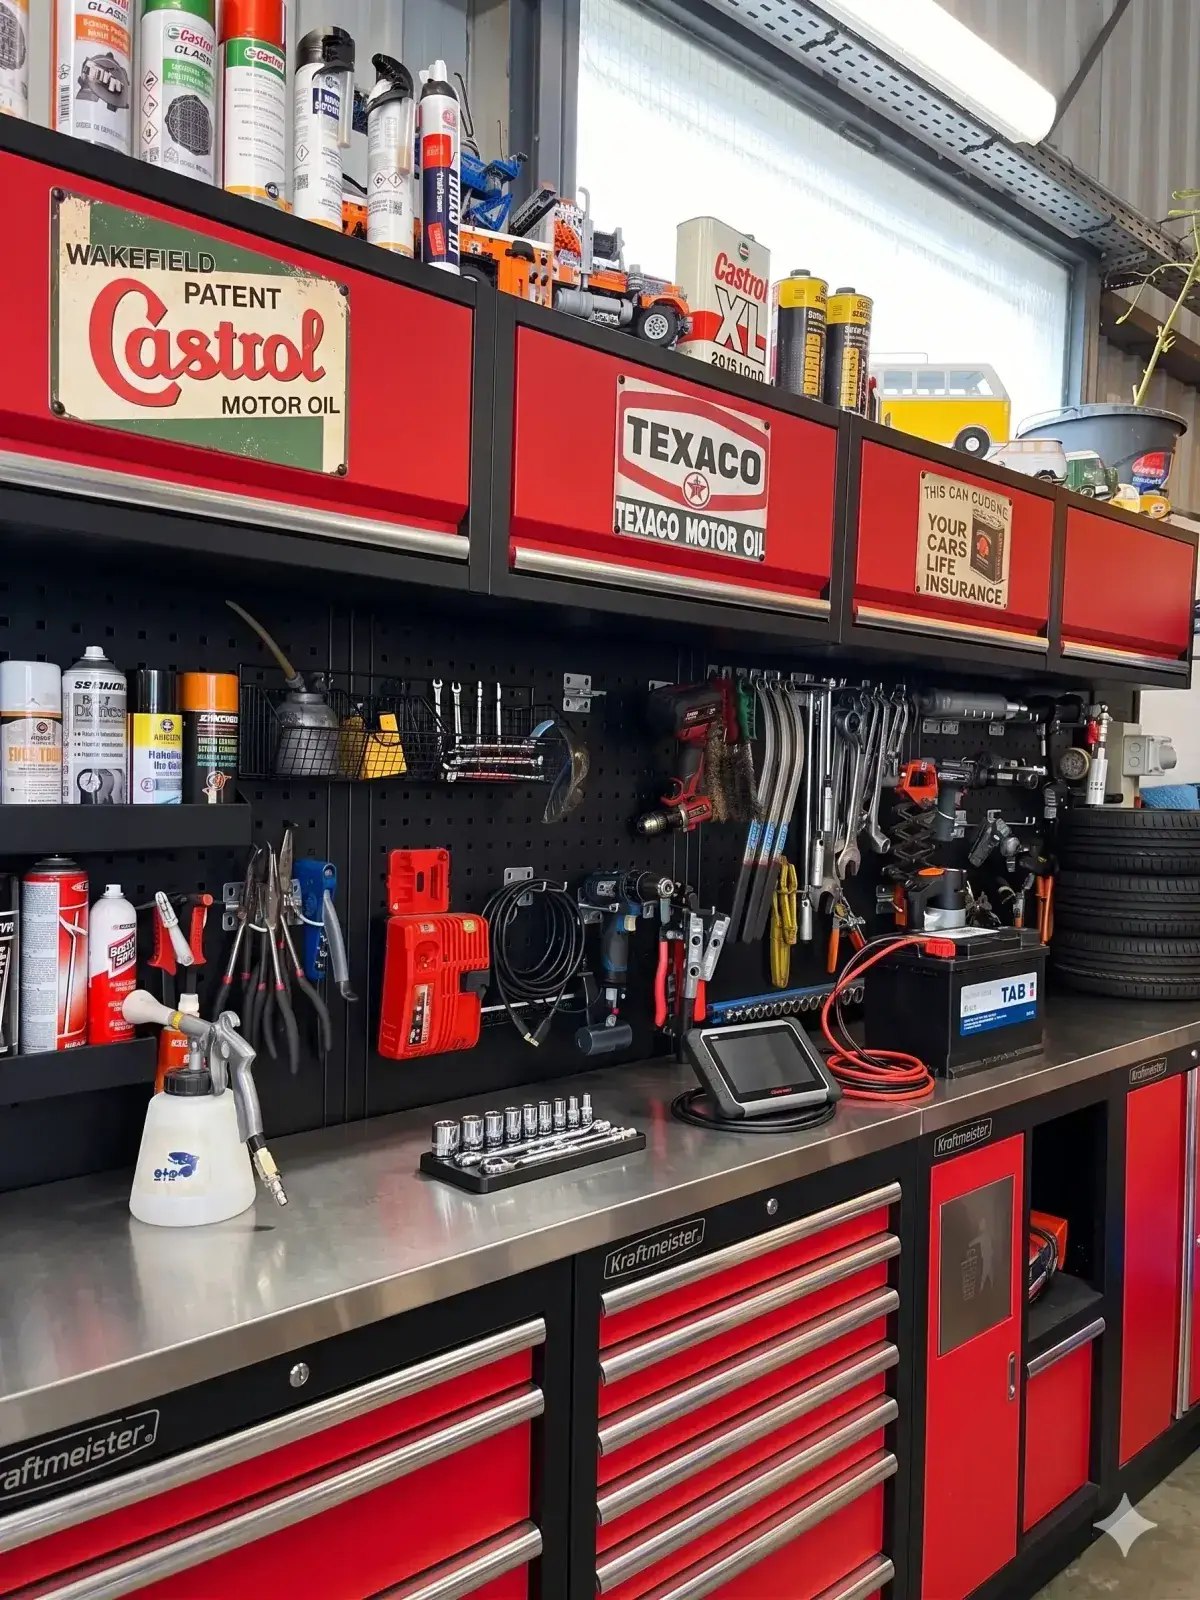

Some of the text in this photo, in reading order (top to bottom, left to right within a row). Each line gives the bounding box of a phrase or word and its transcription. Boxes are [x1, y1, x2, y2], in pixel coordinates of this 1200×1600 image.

[65, 243, 216, 274] WAKEFIELD
[714, 252, 768, 303] Castrol
[184, 281, 281, 310] PATENT
[713, 284, 766, 367] XL
[89, 277, 326, 407] Castrol
[222, 396, 340, 415] MOTOR OIL
[627, 415, 761, 486] TEXACO
[924, 485, 945, 500] THIS
[949, 486, 969, 501] CAN
[616, 501, 765, 557] TEXACO MOTOR OIL
[928, 512, 967, 539] YOUR
[927, 534, 967, 558] CARS
[926, 554, 956, 576] LIFE
[925, 574, 1003, 605] INSURANCE
[1001, 983, 1026, 1003] TAB
[938, 1125, 988, 1152] Kraftmeister
[611, 1228, 699, 1273] Kraftmeister
